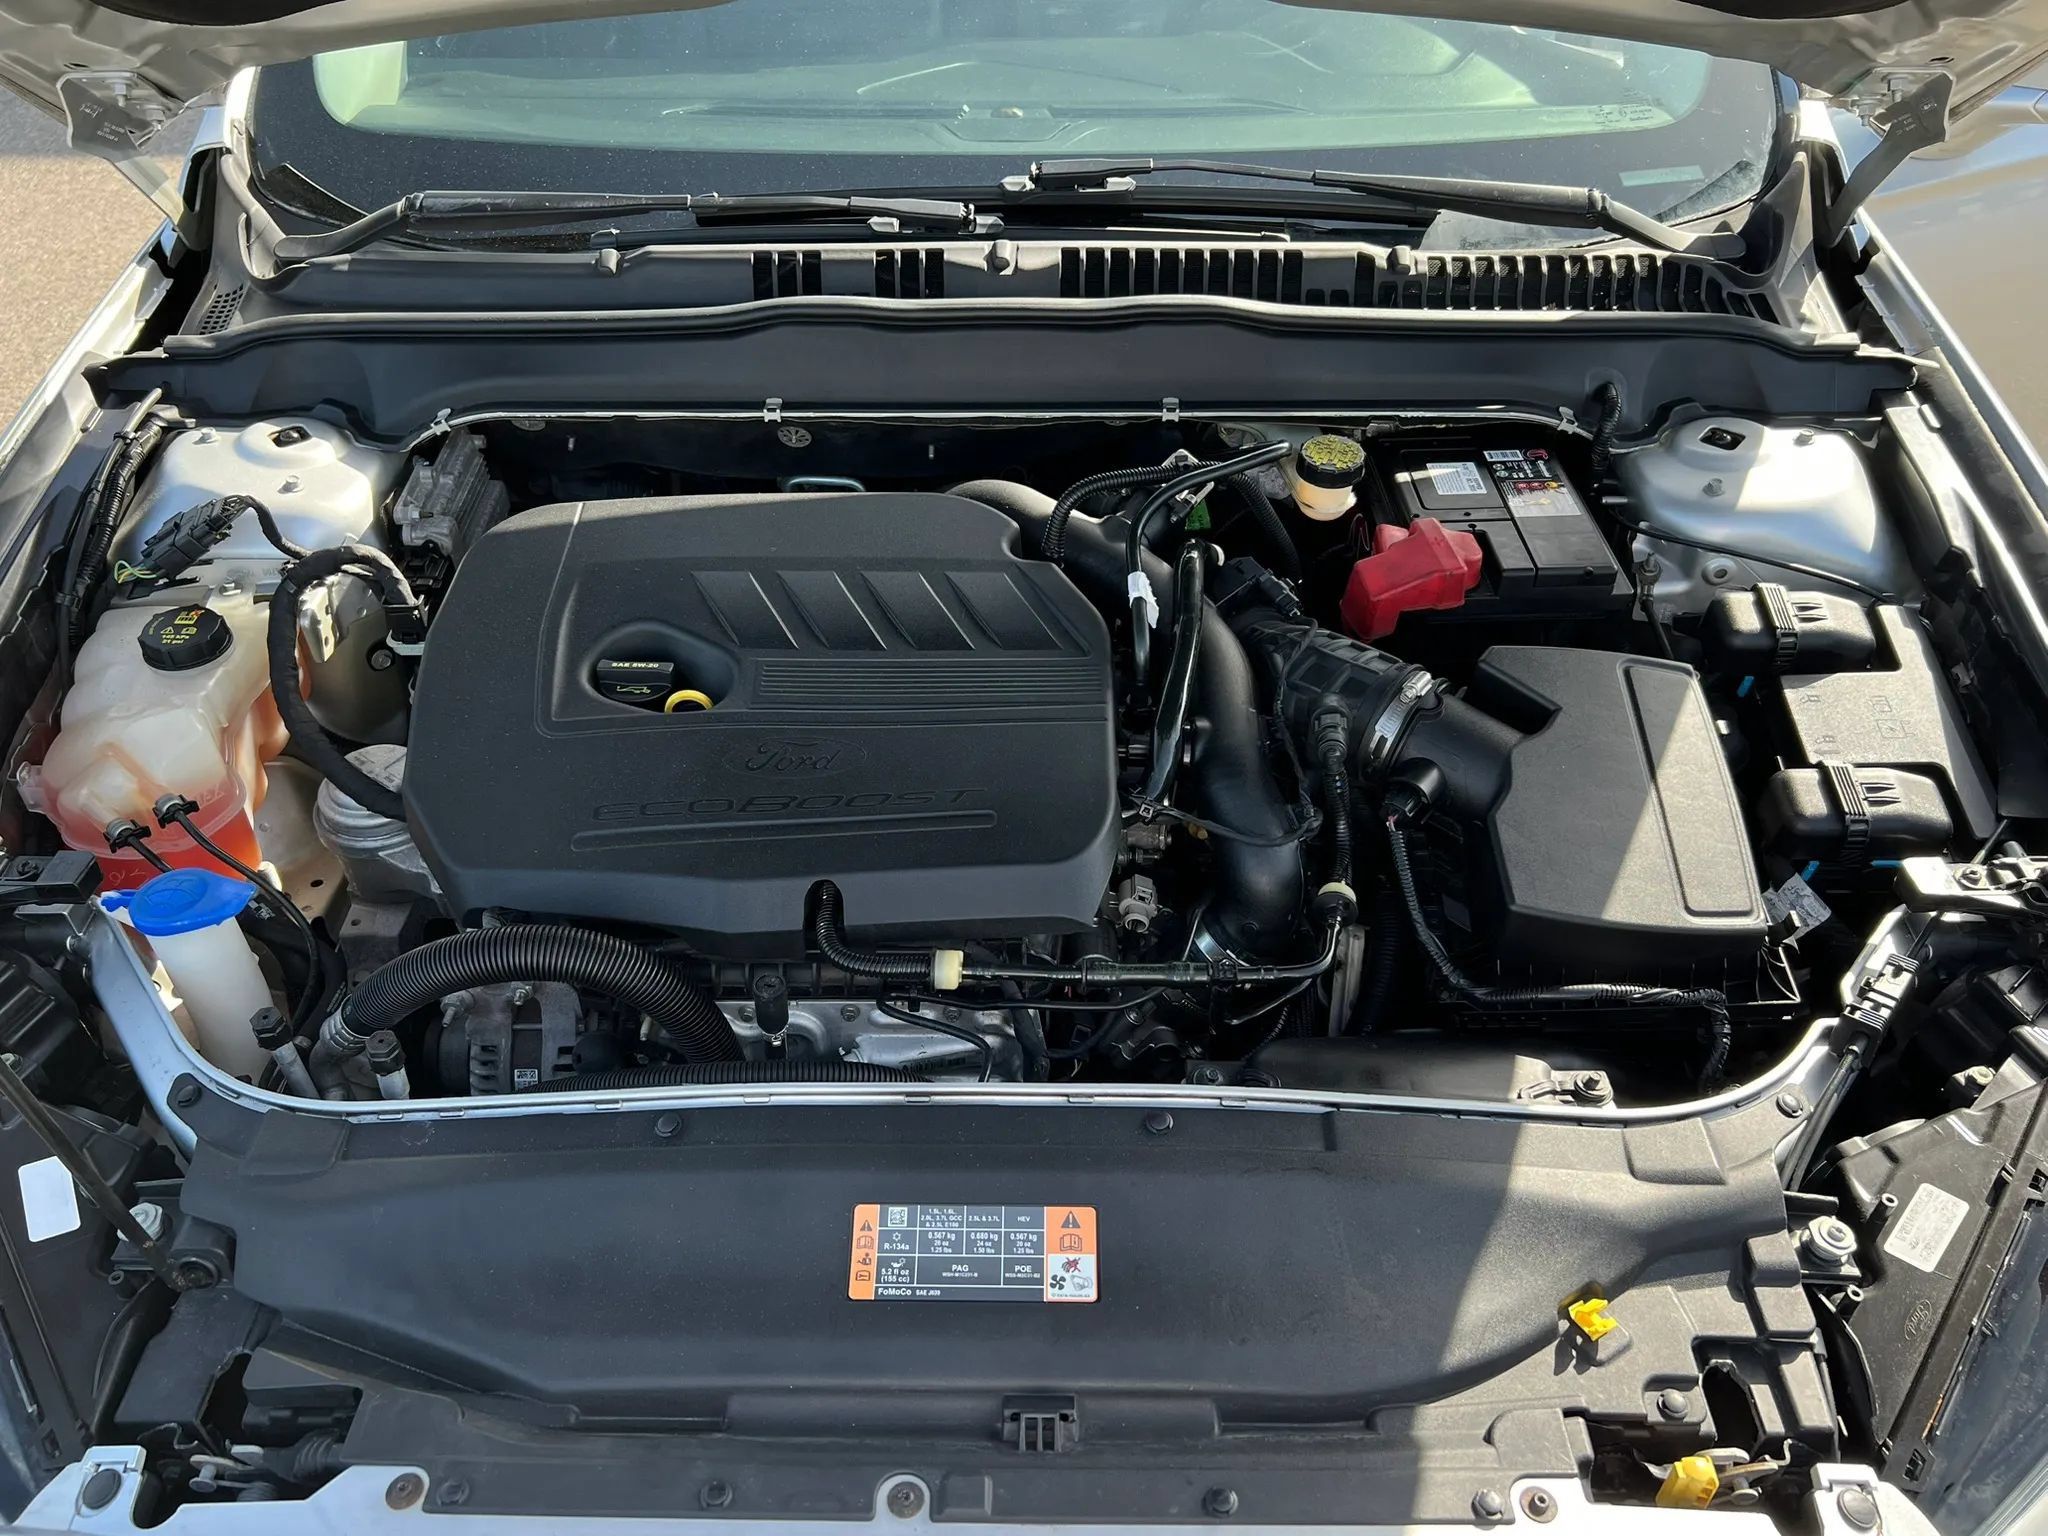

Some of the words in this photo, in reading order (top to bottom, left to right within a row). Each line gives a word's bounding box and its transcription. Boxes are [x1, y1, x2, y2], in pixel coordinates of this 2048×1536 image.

[745, 743, 844, 772] Ford
[947, 1232, 956, 1241] kg
[990, 1232, 998, 1241] kg
[1010, 1232, 1028, 1240] 0.567
[1028, 1232, 1038, 1242] kg
[952, 1264, 969, 1272] PAG
[881, 1275, 897, 1283] (155
[898, 1276, 910, 1284] cc)
[878, 1287, 912, 1296] FoMoCo
